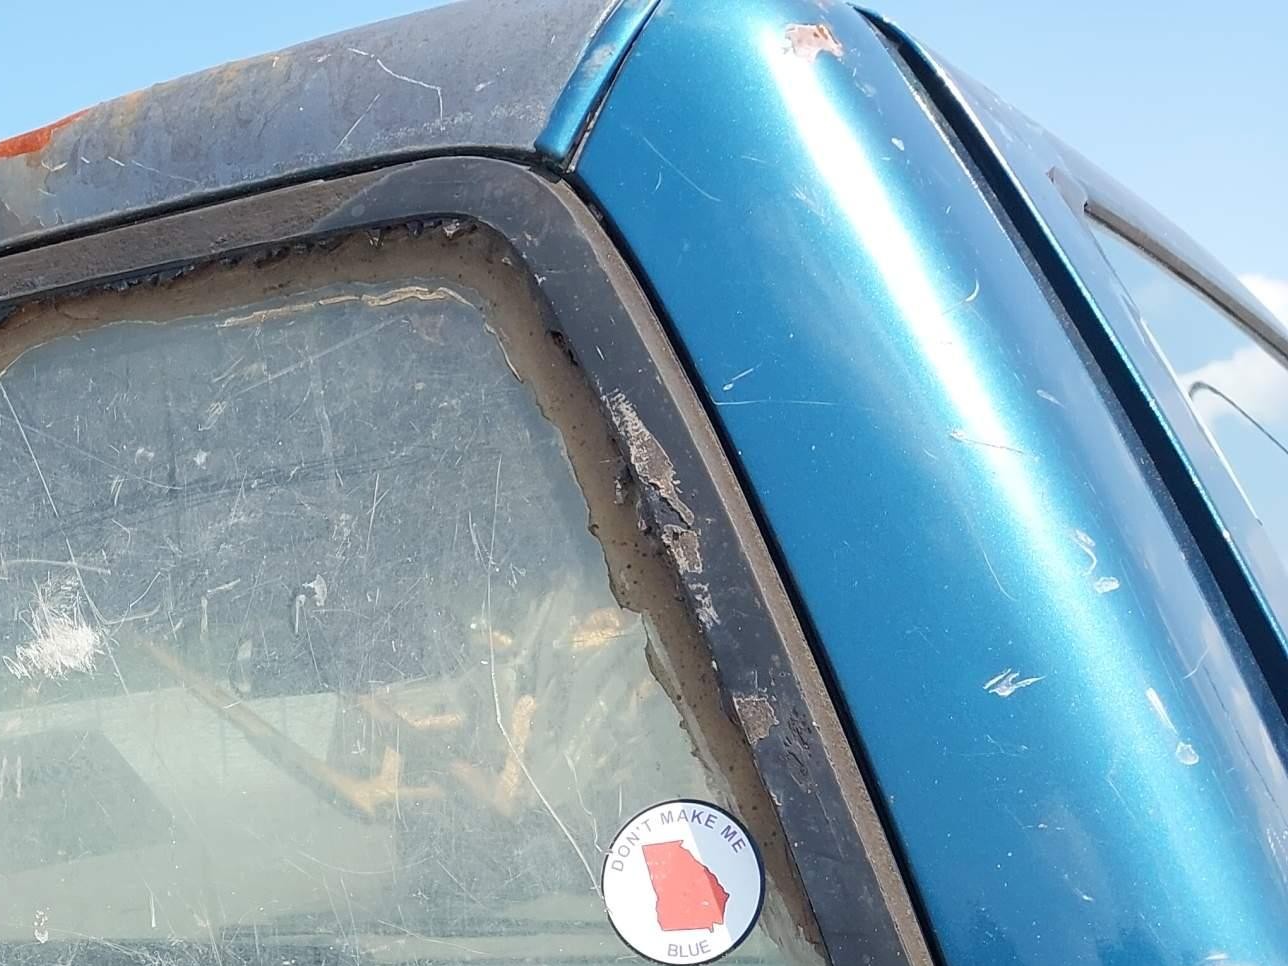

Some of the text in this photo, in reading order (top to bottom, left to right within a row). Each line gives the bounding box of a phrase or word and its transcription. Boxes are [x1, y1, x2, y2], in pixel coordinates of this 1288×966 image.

[611, 808, 746, 872] DON'T MAKE ME
[667, 939, 712, 958] BLUE
